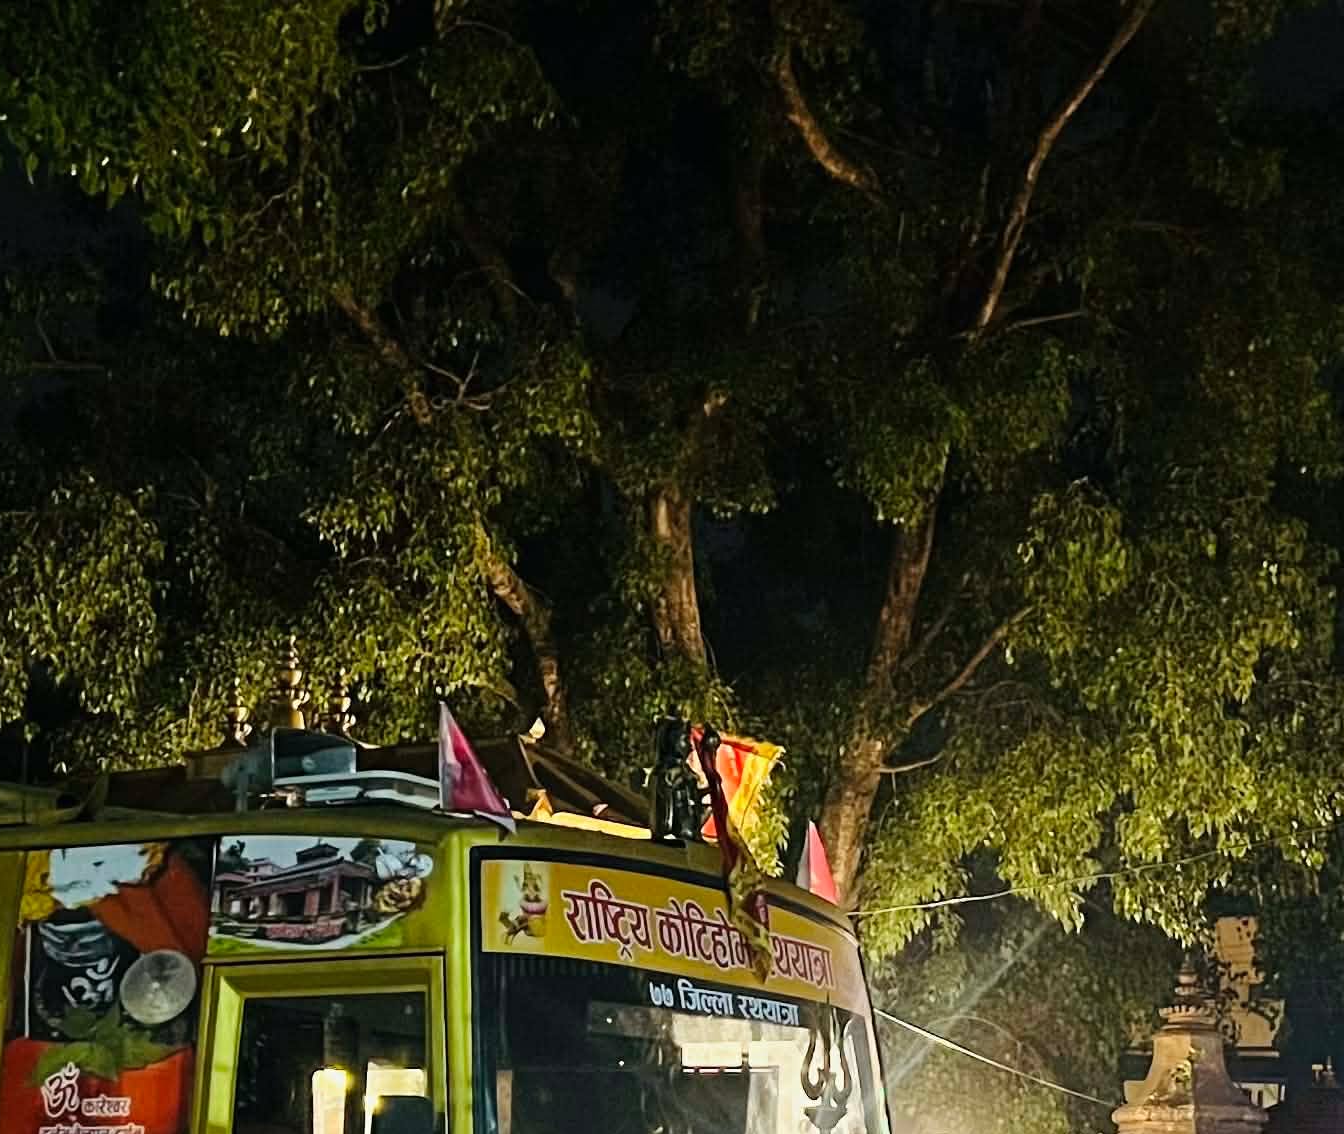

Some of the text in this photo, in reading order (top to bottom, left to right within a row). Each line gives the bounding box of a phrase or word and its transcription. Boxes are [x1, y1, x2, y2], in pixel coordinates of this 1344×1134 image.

[768, 933, 834, 989] थयात्रा
[677, 978, 733, 1016] जिल्ला
[737, 994, 800, 1026] रथयात्रा
